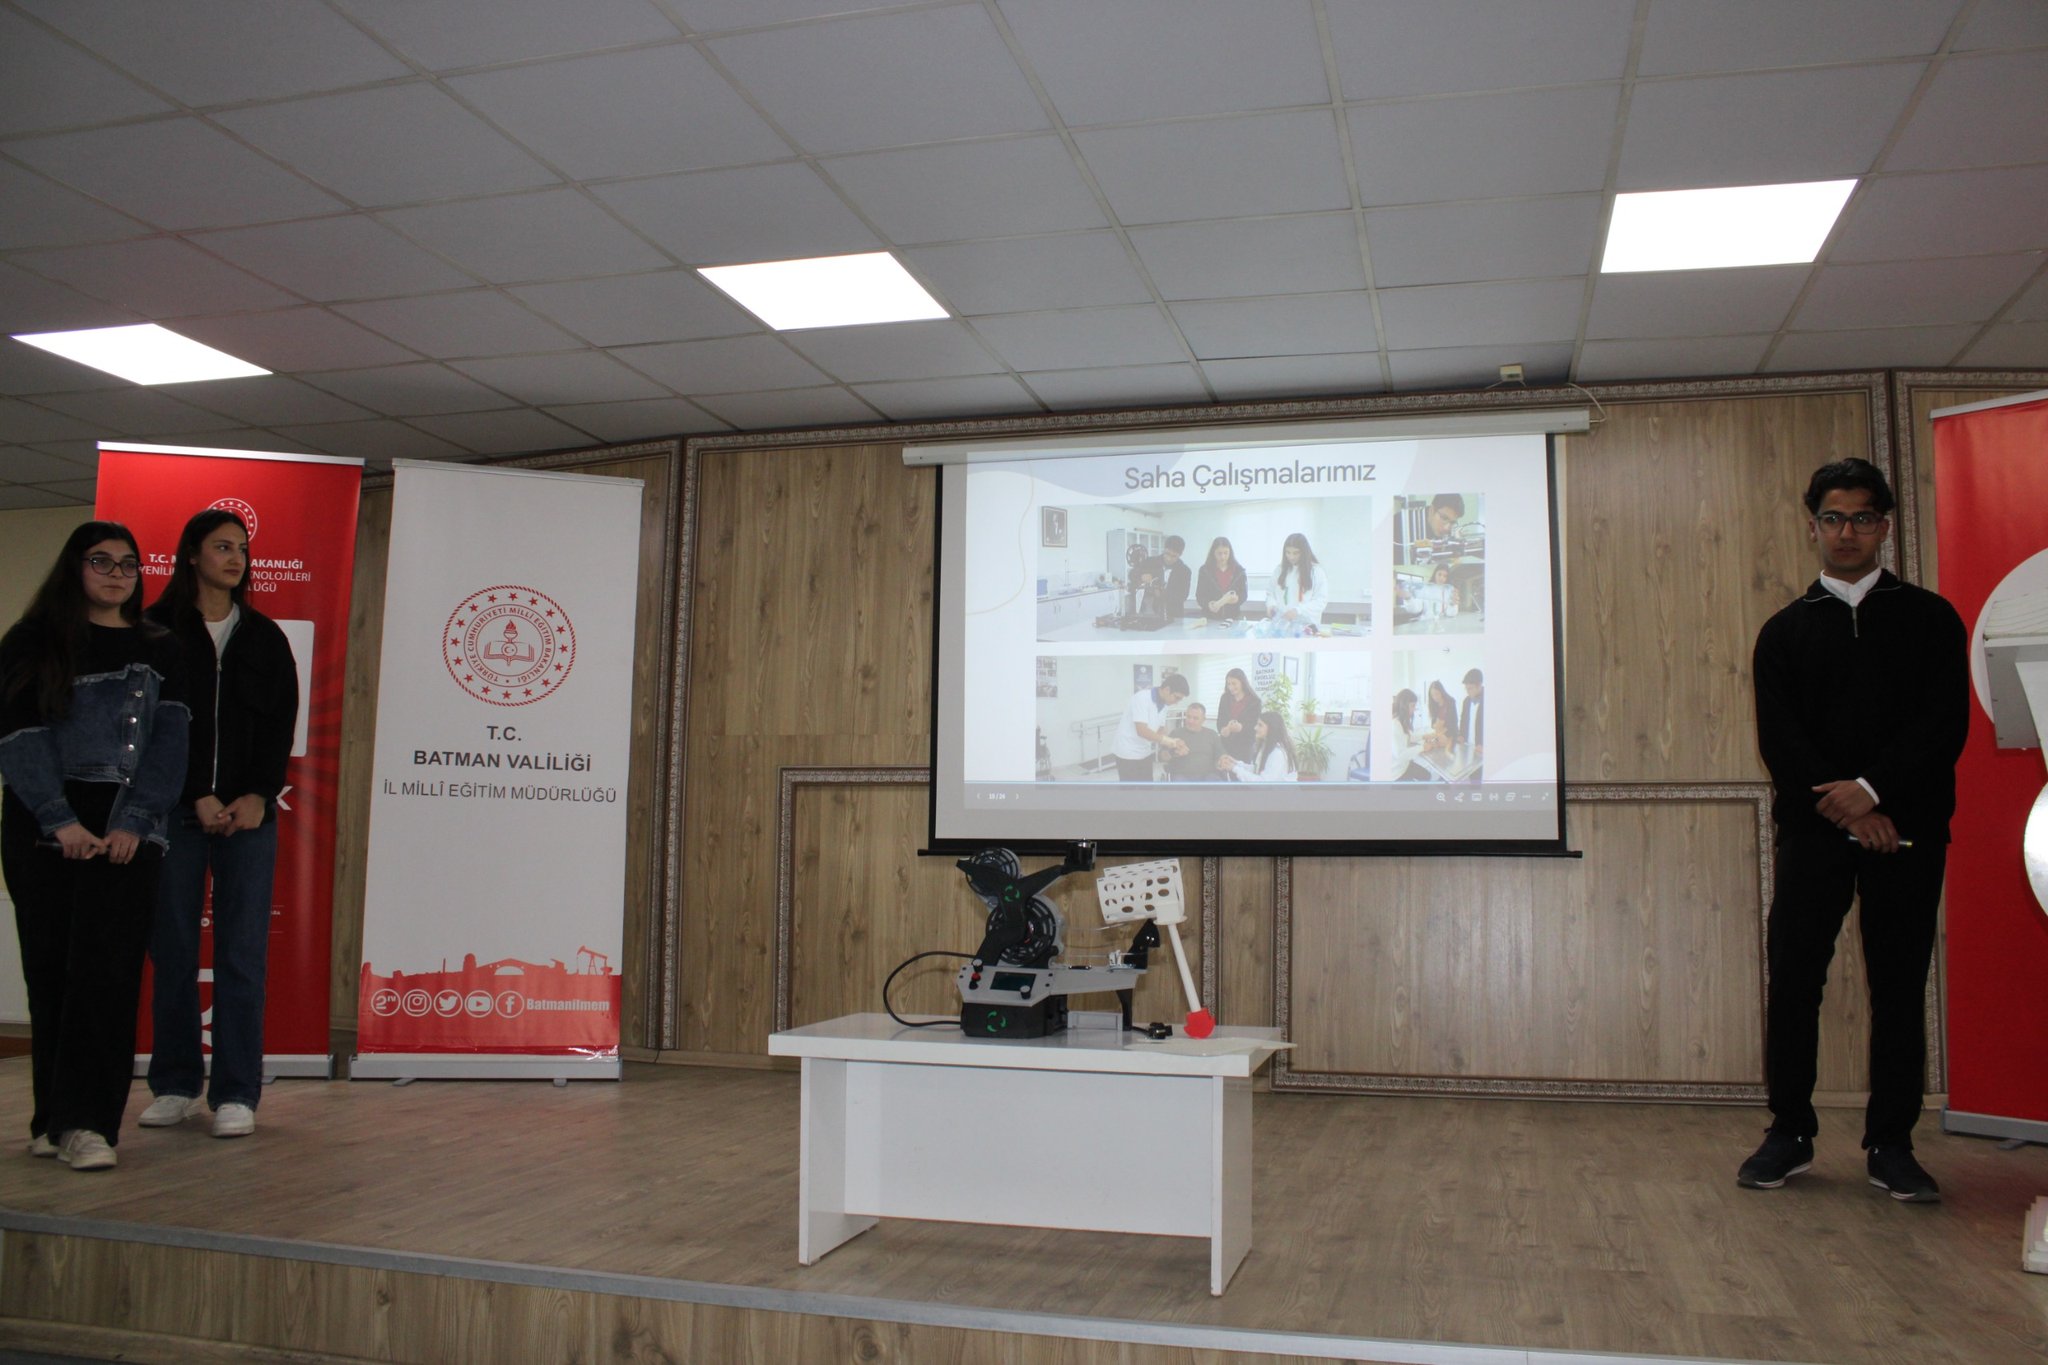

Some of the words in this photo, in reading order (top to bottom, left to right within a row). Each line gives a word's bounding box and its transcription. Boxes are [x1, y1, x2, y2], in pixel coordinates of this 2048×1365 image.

[1124, 465, 1186, 490] Saha
[1192, 459, 1376, 493] Çalışmalarımız
[149, 553, 169, 564] T.C.
[250, 558, 303, 569] AKANLIĞI
[467, 607, 507, 653] CUMHURİYETİ
[534, 617, 553, 646] EĞİTİM
[486, 726, 522, 741] T.C.
[413, 750, 501, 768] BATMAN
[506, 754, 592, 772] VALİLİĞİ
[383, 779, 398, 795] İL
[449, 782, 507, 799] EĞİTİM
[511, 784, 617, 803] MÜDÜRLÜĞÜ
[526, 998, 610, 1011] Batmanilmem
